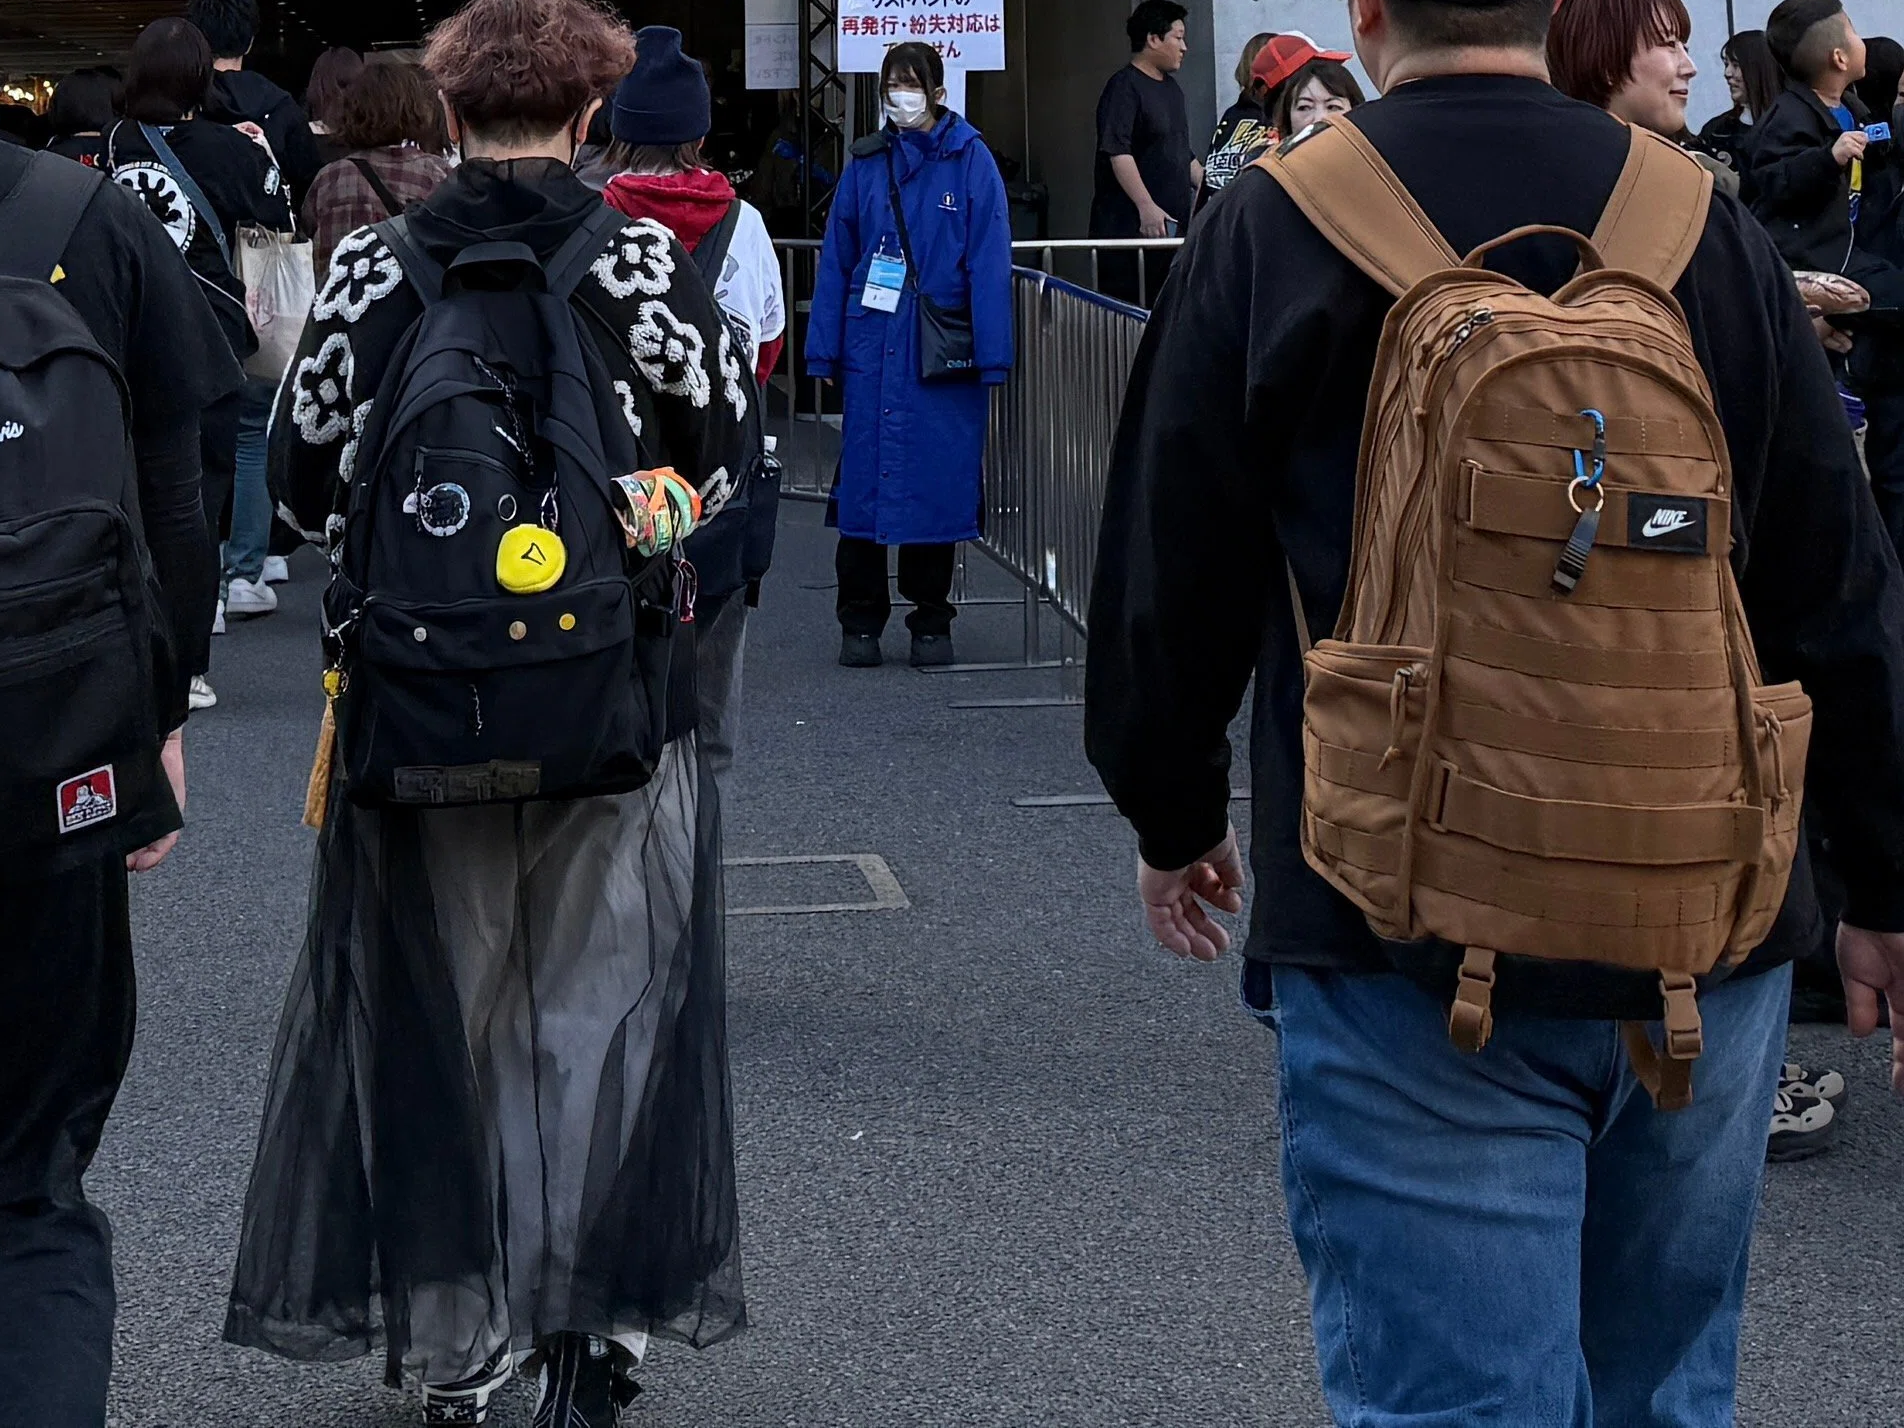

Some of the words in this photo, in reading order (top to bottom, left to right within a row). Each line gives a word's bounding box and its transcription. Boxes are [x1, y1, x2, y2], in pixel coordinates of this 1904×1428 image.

[841, 14, 1001, 35] 再発行・紛失対応は
[1652, 508, 1687, 525] NIKE
